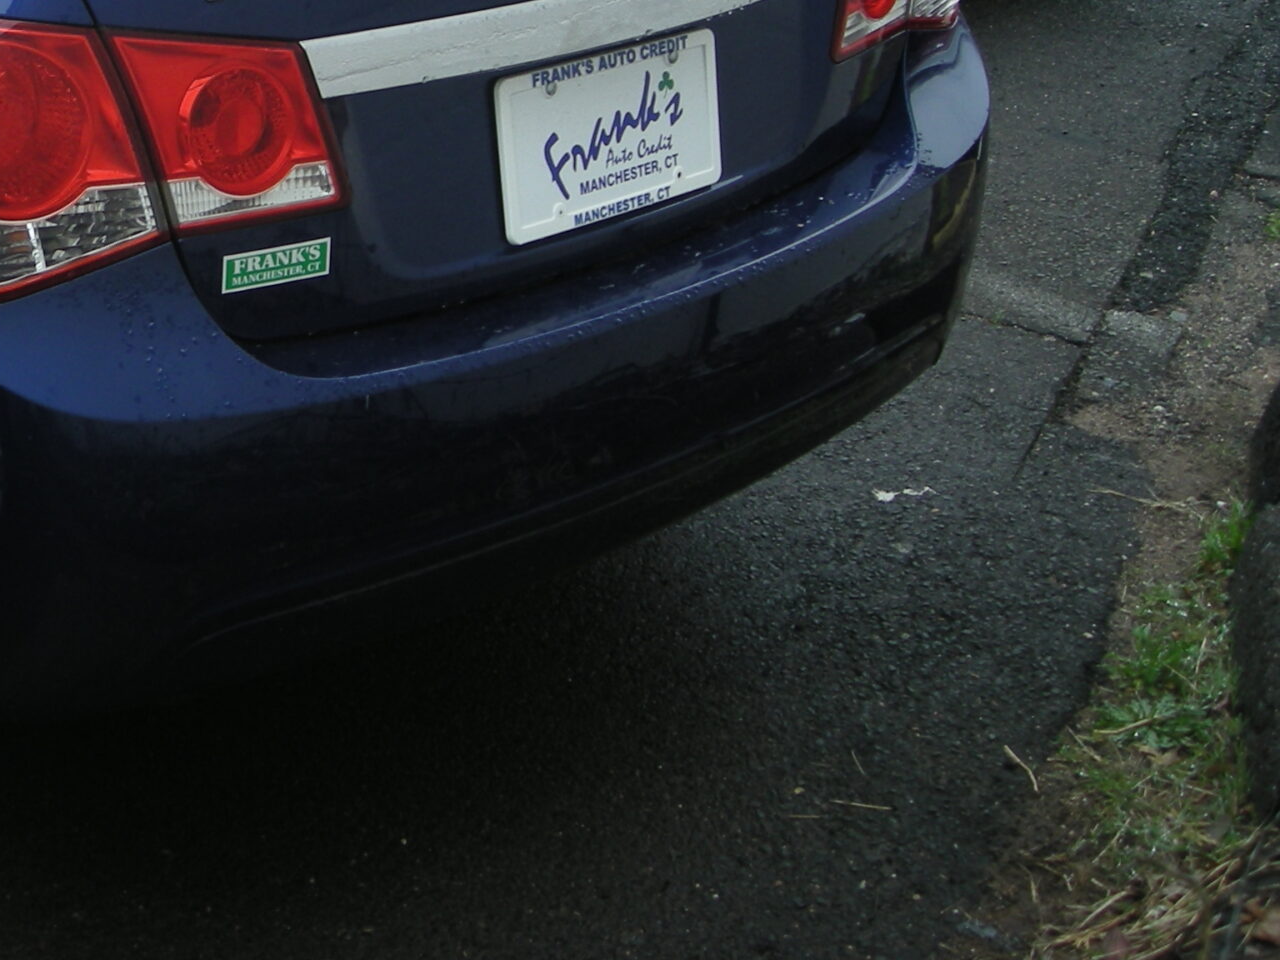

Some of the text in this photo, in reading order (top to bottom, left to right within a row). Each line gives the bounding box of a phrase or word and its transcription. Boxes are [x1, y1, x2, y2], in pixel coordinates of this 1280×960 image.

[531, 35, 689, 88] FRANK'S AUTO CREDIT
[544, 70, 684, 201] Frank's
[605, 134, 673, 169] Auto Credit
[579, 153, 679, 196] MANCHESTER, CT
[574, 185, 671, 227] MANCHESTER, CT
[232, 261, 321, 286] MANCHESTER, CT
[233, 244, 321, 275] FRANK'S
